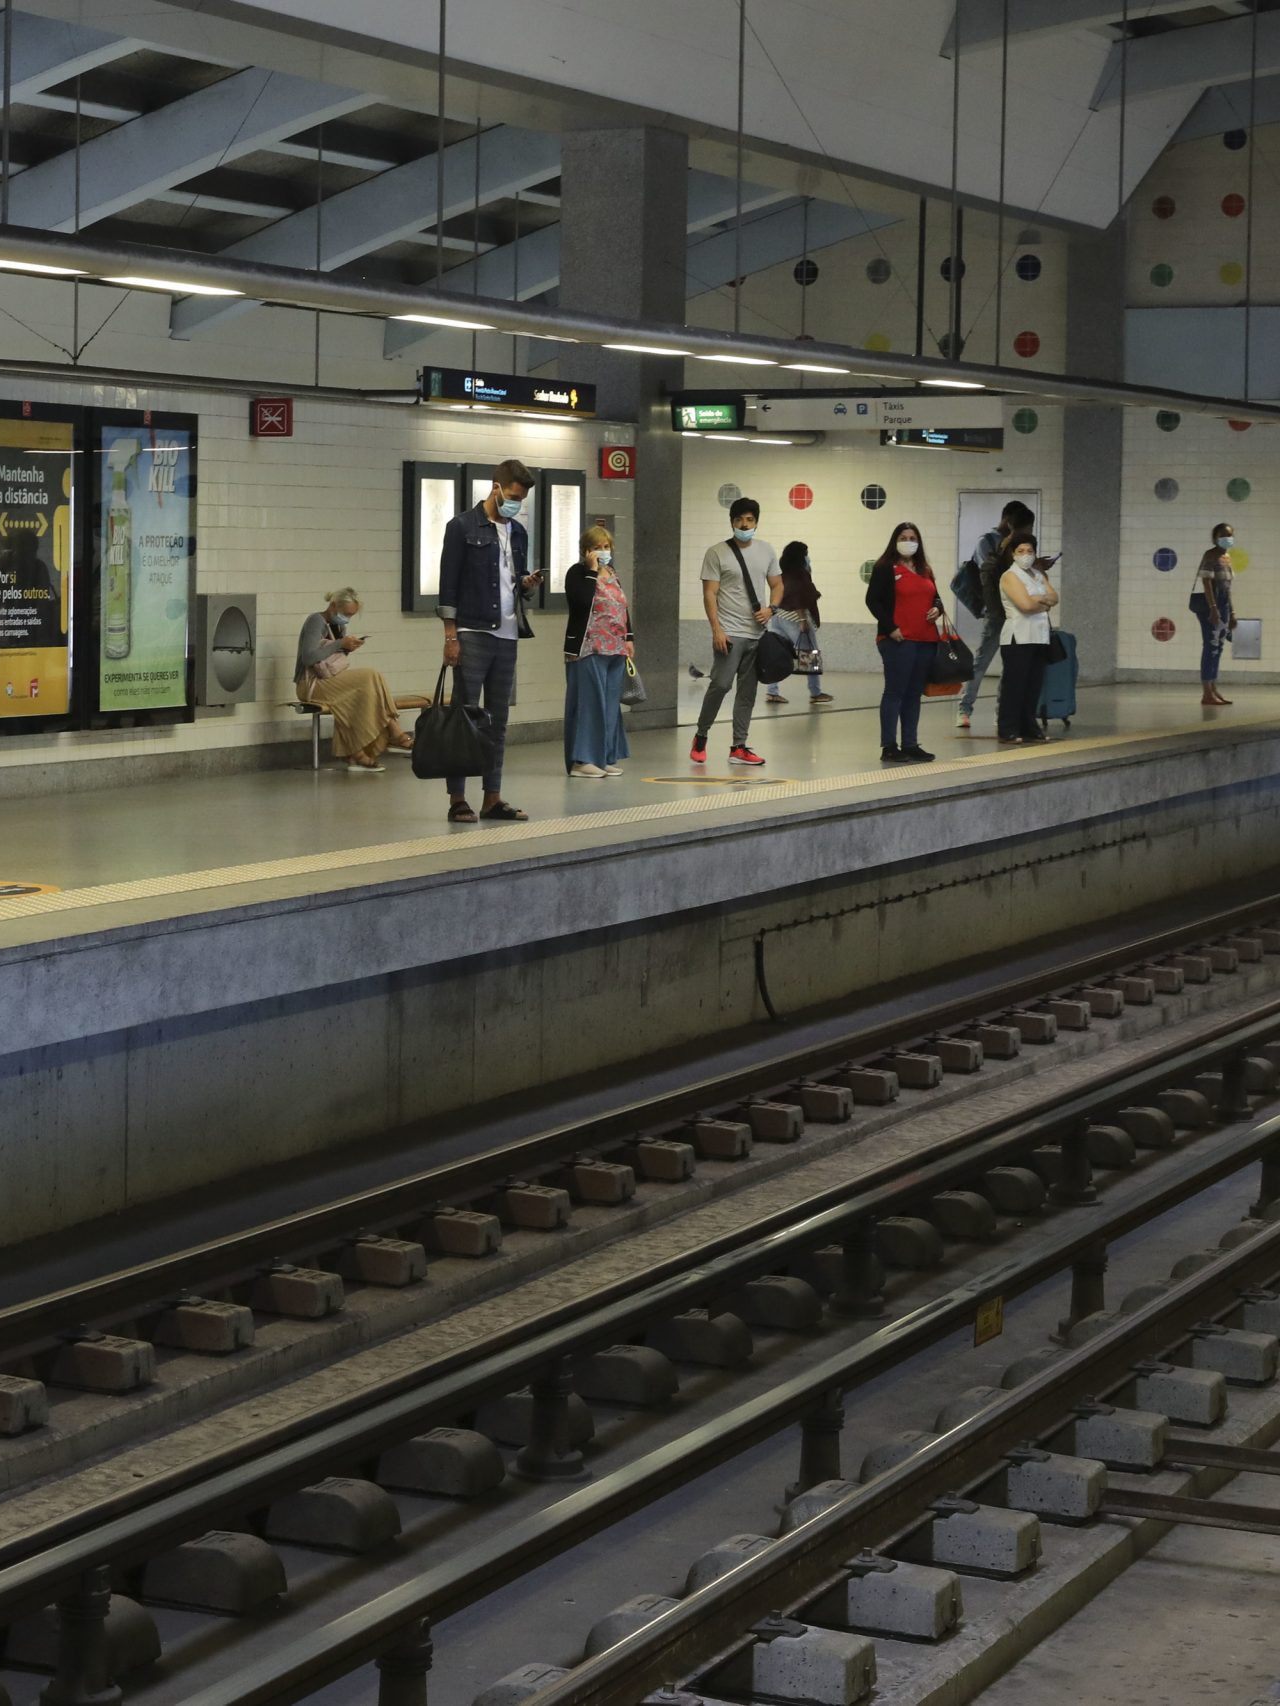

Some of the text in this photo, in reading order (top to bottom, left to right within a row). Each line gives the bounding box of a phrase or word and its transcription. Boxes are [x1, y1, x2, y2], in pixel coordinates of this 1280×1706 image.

[699, 417, 732, 425] emergência
[883, 415, 912, 425] Parque
[153, 439, 180, 467] BIO
[148, 465, 177, 493] KILL
[4, 487, 49, 505] distância
[112, 526, 126, 545] BIO
[138, 532, 184, 551] A PROTEÇÃO
[109, 545, 124, 565] KILL
[147, 555, 152, 567] O
[153, 555, 180, 567] MELHOR
[9, 570, 17, 584] si
[149, 572, 173, 586] ATAQUE
[2, 585, 22, 603] pelos
[23, 587, 51, 600] outros.
[8, 606, 38, 617] aglomerações
[4, 617, 24, 626] entradas
[104, 670, 179, 683] EXPERIMENTA SE QUERES VER
